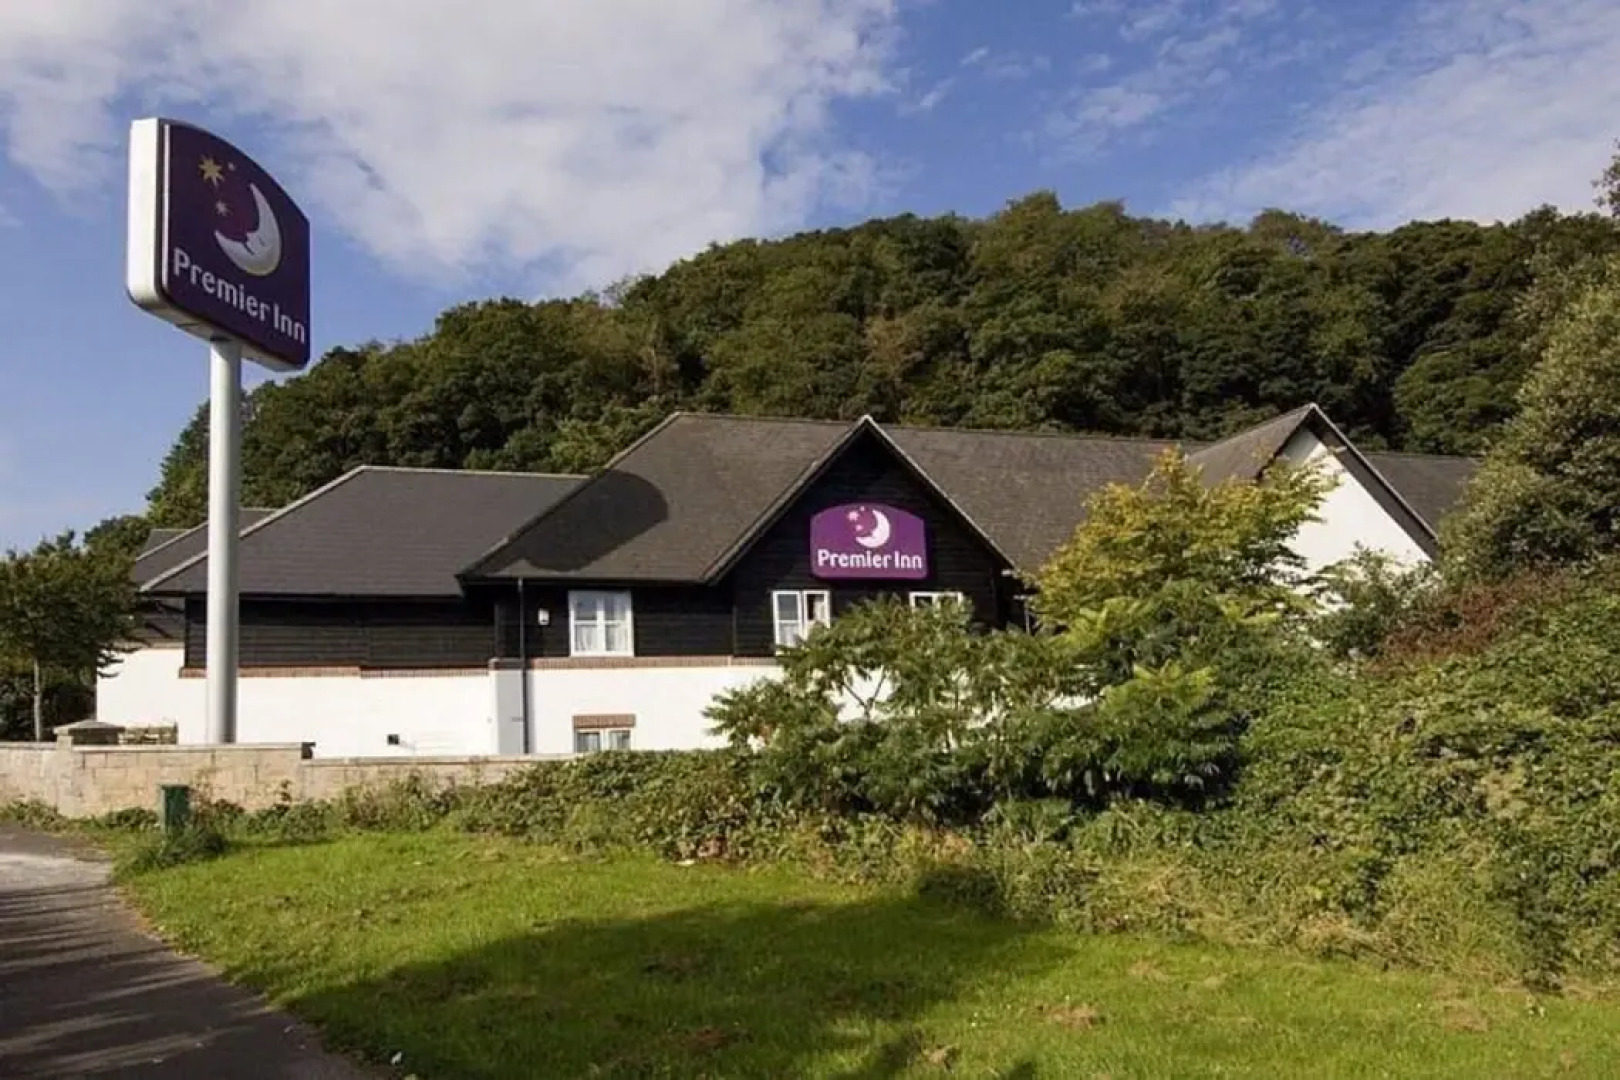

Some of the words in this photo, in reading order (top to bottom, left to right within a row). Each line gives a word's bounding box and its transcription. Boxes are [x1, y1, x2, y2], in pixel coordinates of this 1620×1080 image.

[173, 247, 270, 322] Premier
[273, 303, 305, 344] Inn
[817, 548, 892, 568] Premier
[894, 550, 922, 569] Inn
